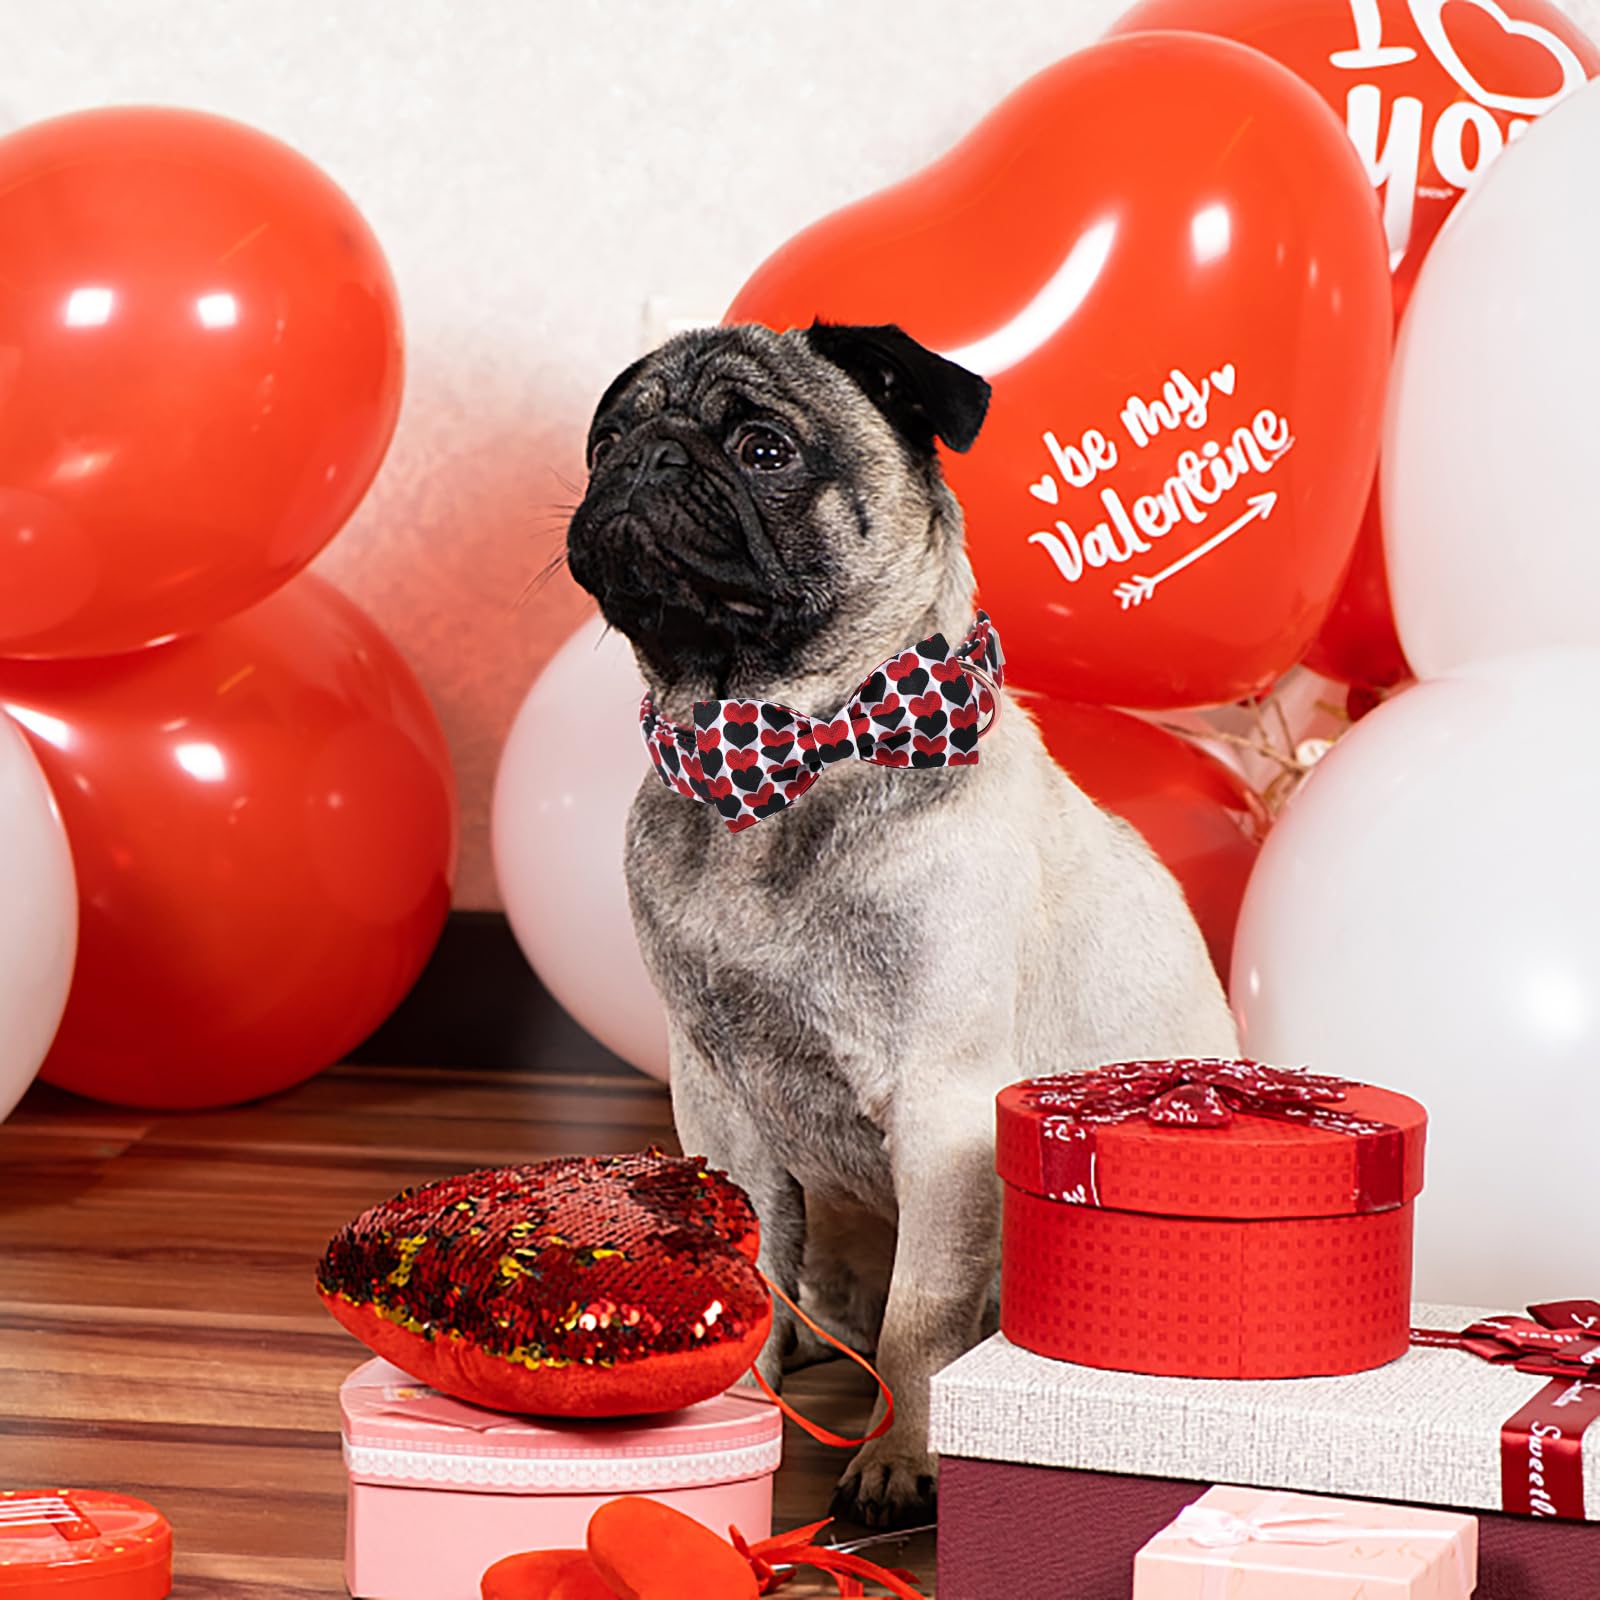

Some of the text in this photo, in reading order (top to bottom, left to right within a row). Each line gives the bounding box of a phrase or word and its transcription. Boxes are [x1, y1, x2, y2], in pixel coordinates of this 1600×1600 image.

[1347, 84, 1528, 273] yo
[1028, 409, 1289, 582] Valentine
[1043, 369, 1210, 488] be my
